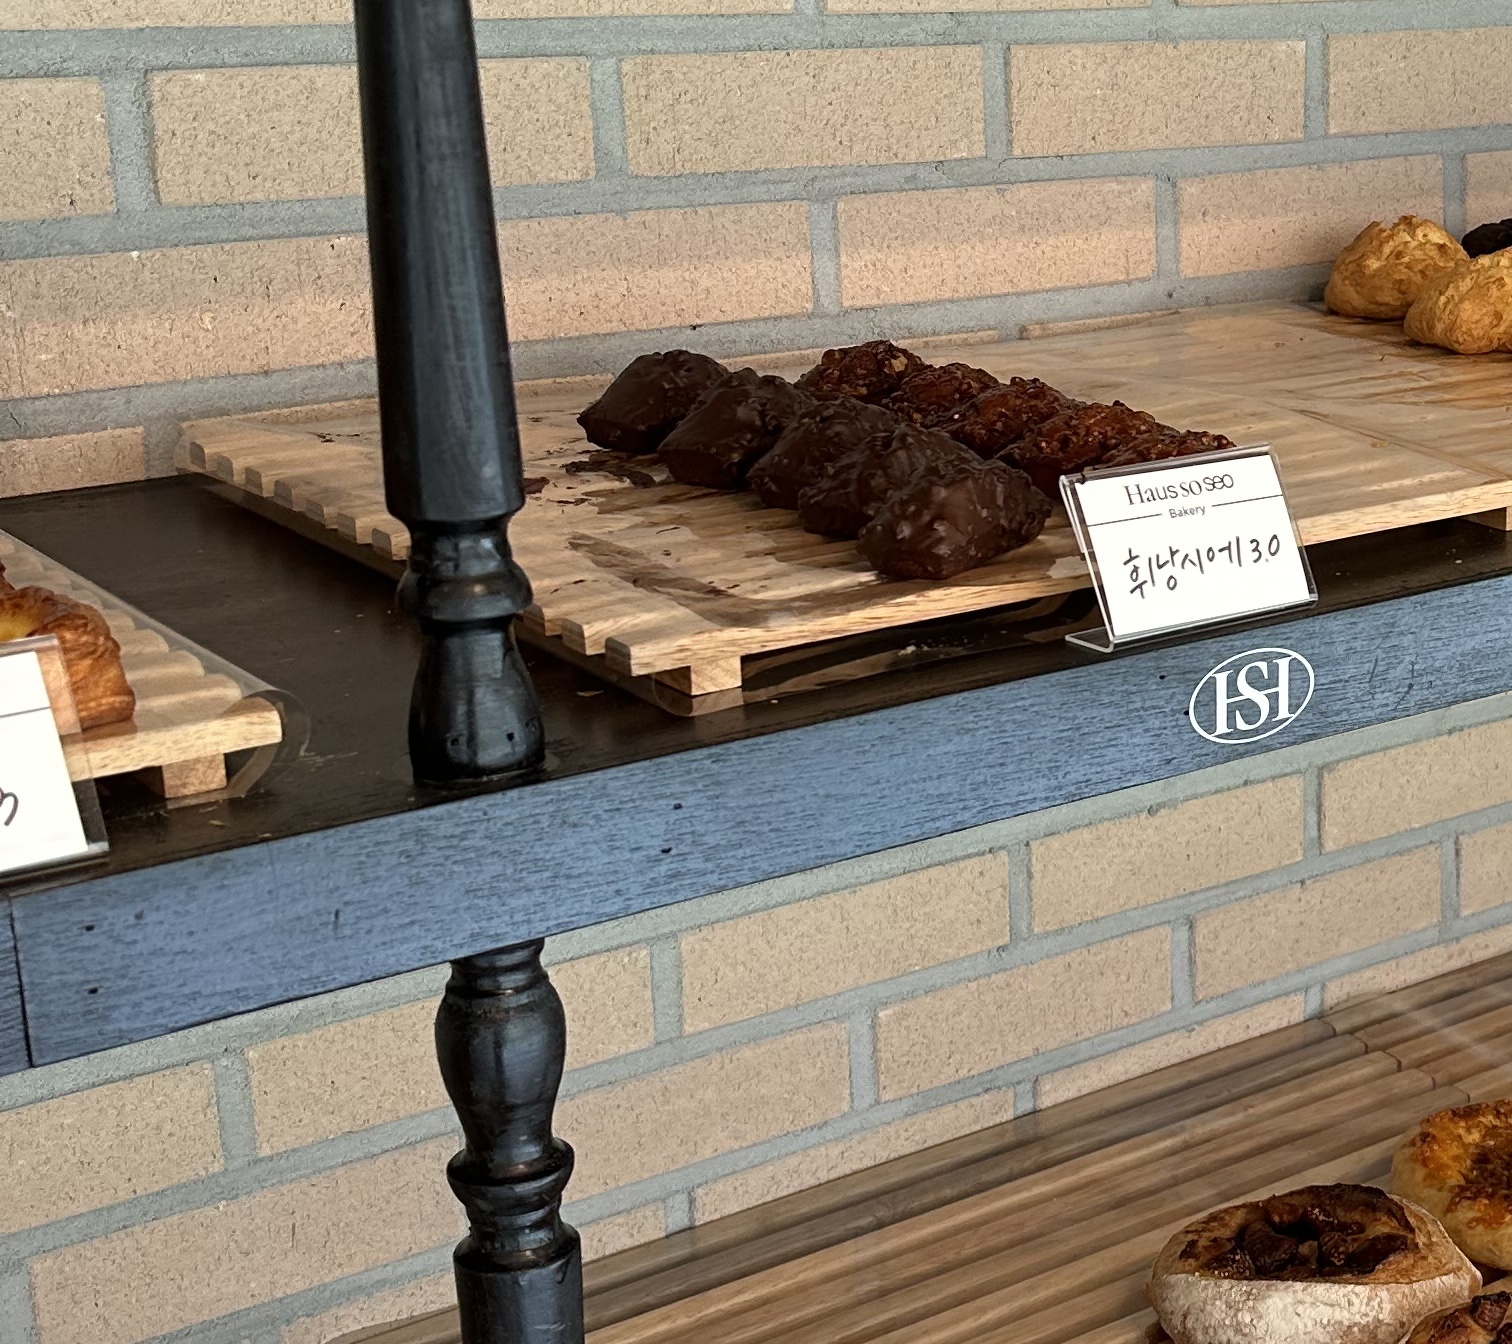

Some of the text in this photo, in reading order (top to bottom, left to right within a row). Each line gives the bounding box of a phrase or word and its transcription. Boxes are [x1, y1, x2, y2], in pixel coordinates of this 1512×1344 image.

[1168, 504, 1207, 520] Bakery
[1122, 533, 1281, 599] 휘낭시에 3.0
